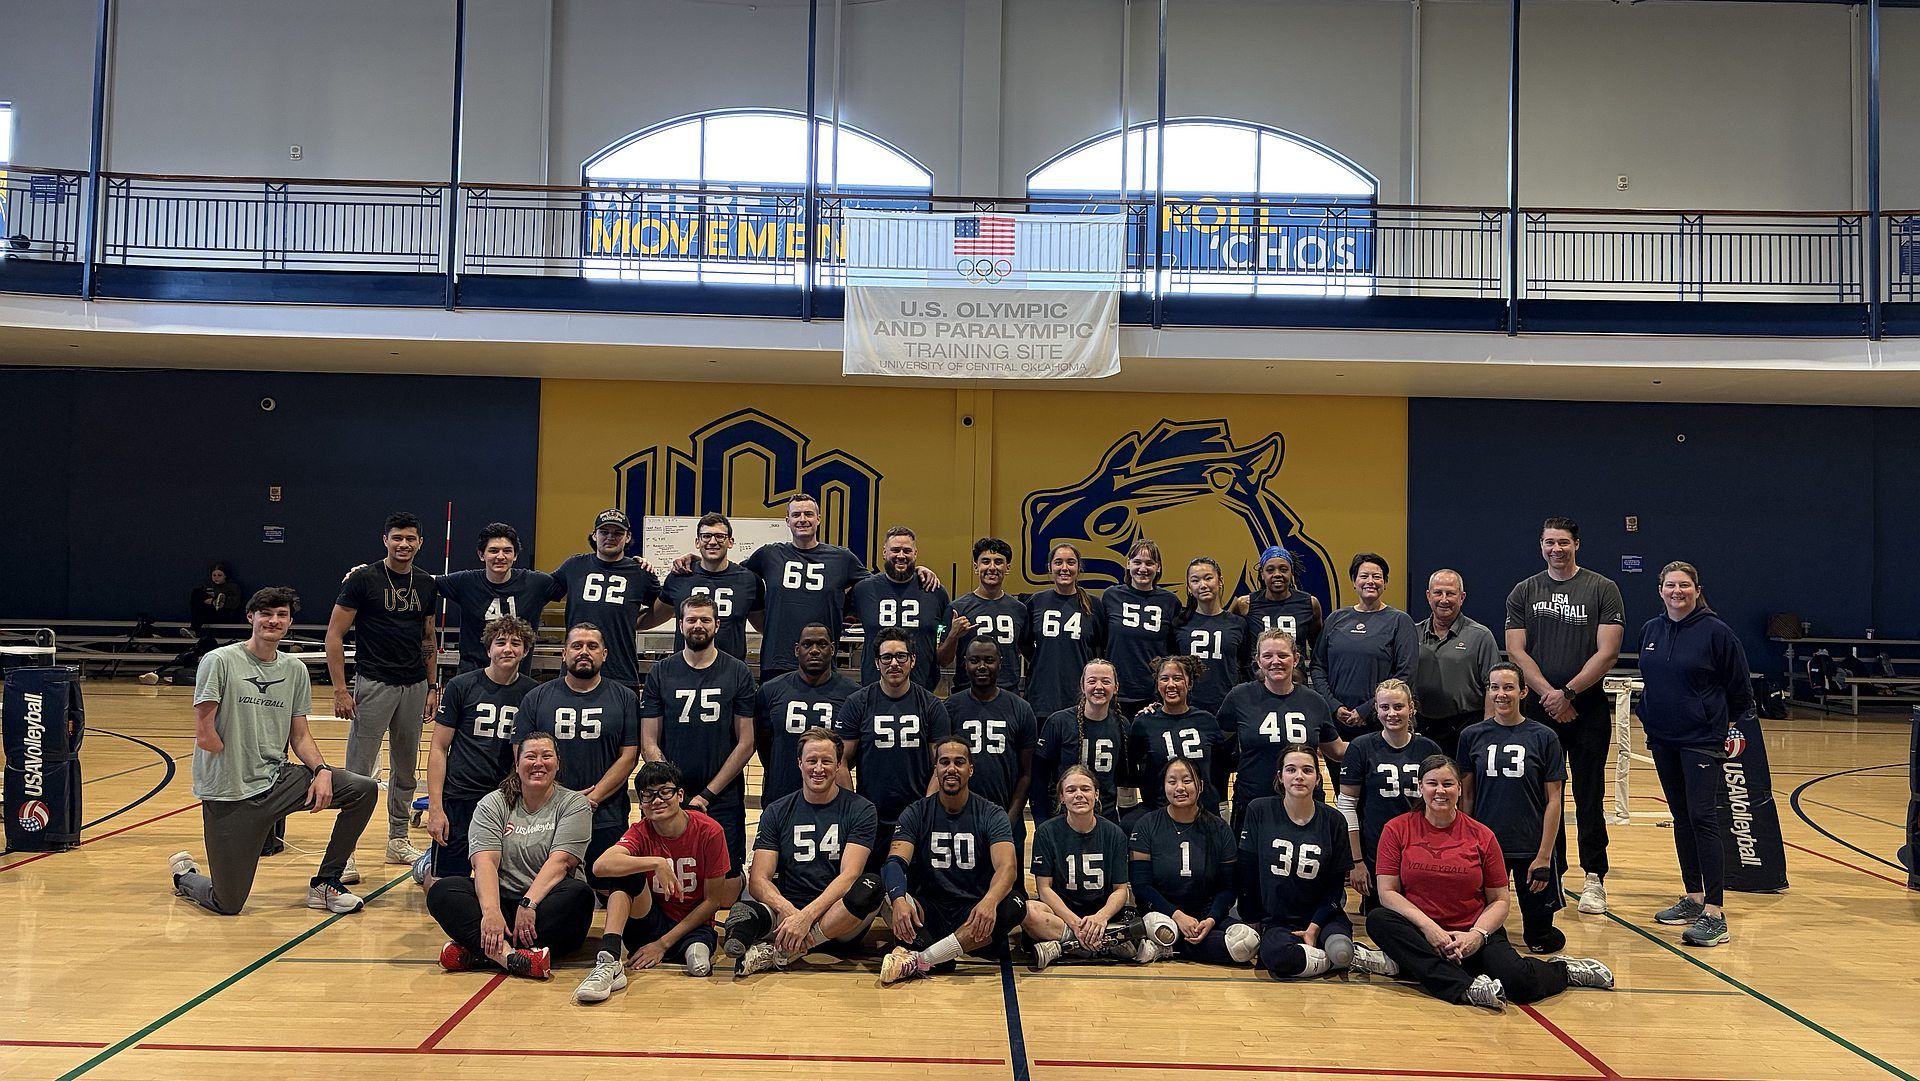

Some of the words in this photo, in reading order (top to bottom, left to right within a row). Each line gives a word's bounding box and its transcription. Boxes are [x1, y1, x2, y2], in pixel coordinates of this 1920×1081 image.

[1162, 197, 1282, 234] ROLL
[900, 301, 947, 318] U.S.
[956, 302, 1068, 319] OLYMPIC
[874, 321, 927, 338] AND
[936, 322, 1093, 340] PARALYMPIC
[879, 360, 943, 371] UNIVERSITY
[949, 362, 963, 372] OF
[966, 362, 1017, 372] CENTRAL
[1021, 363, 1087, 373] OKLAHOMA
[903, 342, 1009, 360] TRAINING
[1017, 344, 1063, 361] SITE
[582, 573, 628, 605] 62
[782, 561, 825, 591] 65
[384, 588, 422, 612] USA
[484, 596, 517, 621] 41
[878, 599, 920, 627] 82
[1532, 601, 1588, 618] VOLLEYBALL
[1551, 593, 1569, 605] USA
[975, 615, 1015, 644] 29
[1042, 610, 1082, 640] 64
[1122, 602, 1162, 633] 53
[1190, 629, 1222, 660] 21
[238, 696, 284, 709] VOLLEYBALL
[675, 688, 721, 723] 75
[785, 700, 833, 734] 63
[473, 703, 519, 740] 28
[554, 707, 603, 740] 85
[874, 714, 920, 749] 52
[962, 720, 1007, 754] 35
[1259, 711, 1307, 744] 46
[1080, 738, 1114, 772] 16
[1162, 727, 1204, 762] 12
[1485, 744, 1526, 778] 13
[1376, 763, 1422, 799] 33
[793, 823, 841, 862] 54
[930, 831, 976, 870] 50
[1270, 838, 1322, 879] 36
[1065, 853, 1104, 891] 15
[1179, 841, 1192, 877] 1
[1408, 861, 1470, 874] VOLLEYBALL
